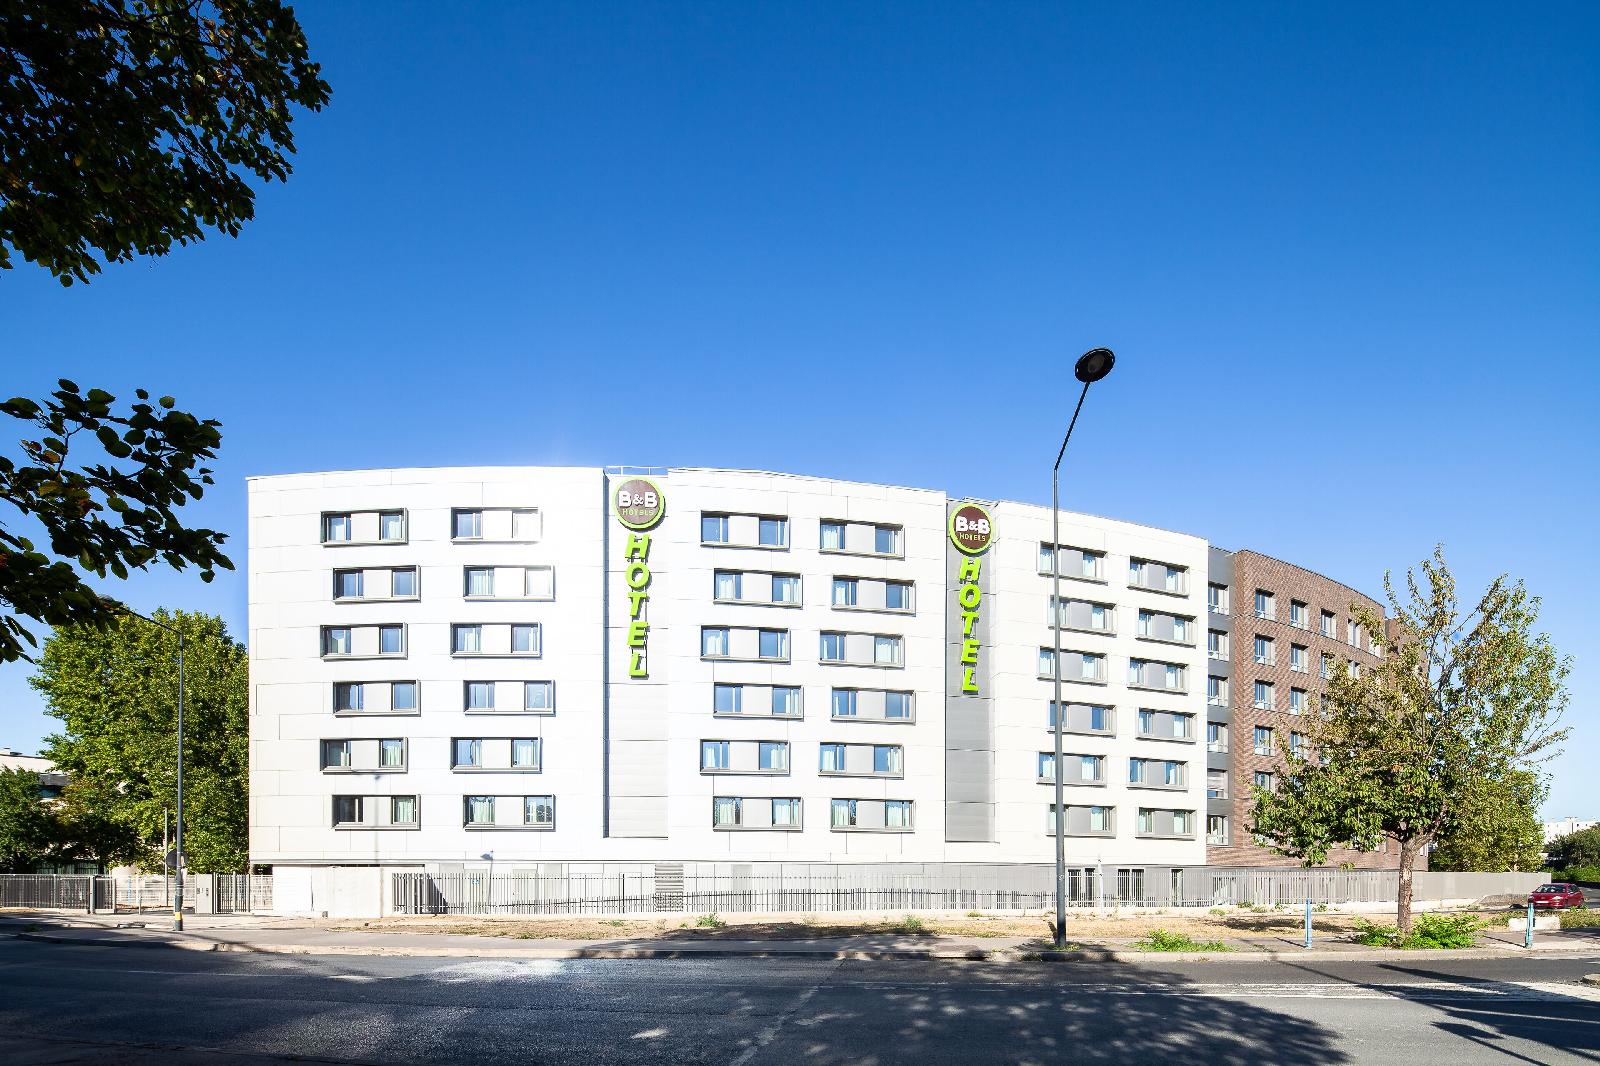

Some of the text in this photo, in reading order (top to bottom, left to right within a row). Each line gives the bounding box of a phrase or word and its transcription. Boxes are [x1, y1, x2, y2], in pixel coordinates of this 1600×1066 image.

[618, 490, 658, 508] B&B
[622, 508, 654, 516] HOTELS
[955, 515, 991, 535] B&B
[960, 532, 986, 542] HOTELS
[624, 533, 651, 677] HOTEL
[959, 556, 982, 692] HOTEL
